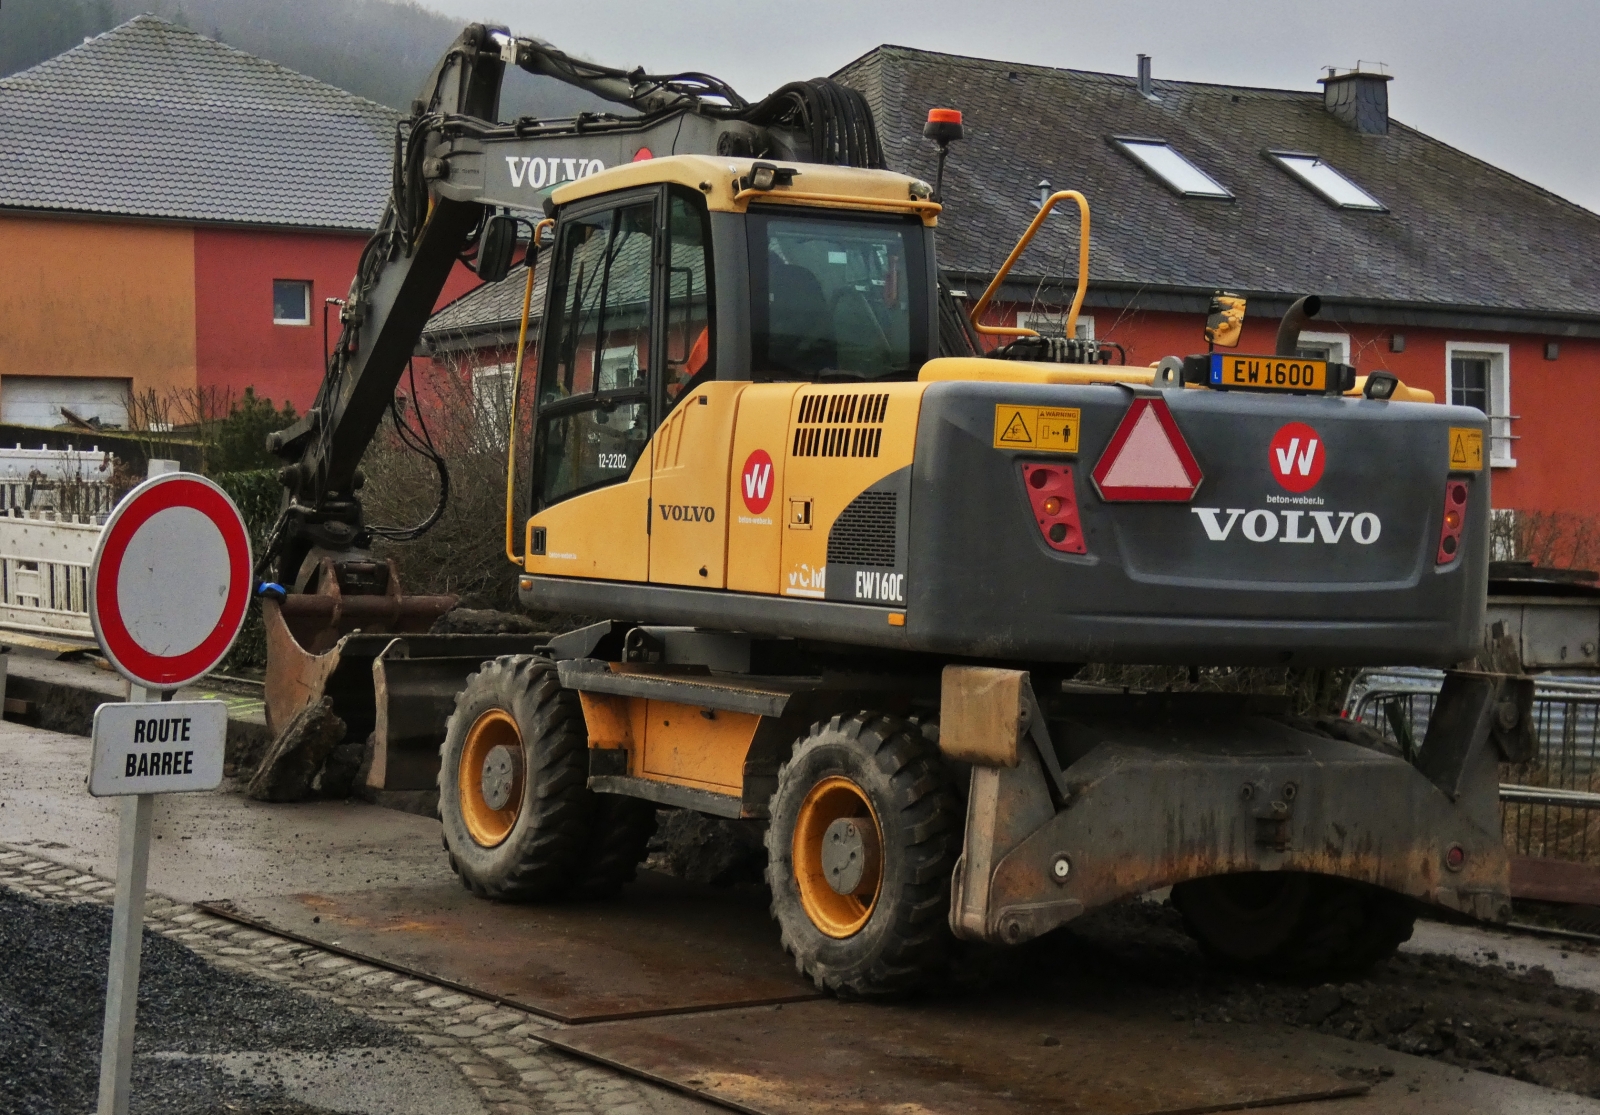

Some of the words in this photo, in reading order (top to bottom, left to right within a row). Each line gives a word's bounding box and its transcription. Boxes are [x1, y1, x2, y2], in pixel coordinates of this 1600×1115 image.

[1214, 371, 1219, 380] L
[598, 453, 627, 469] 12-2202
[1266, 494, 1325, 505] beton-weber.lu
[659, 504, 716, 523] VOLVO
[1191, 507, 1382, 545] VOLVO
[855, 570, 904, 601] EW160C
[133, 718, 192, 743] ROUTE
[125, 751, 194, 777] BARREE
